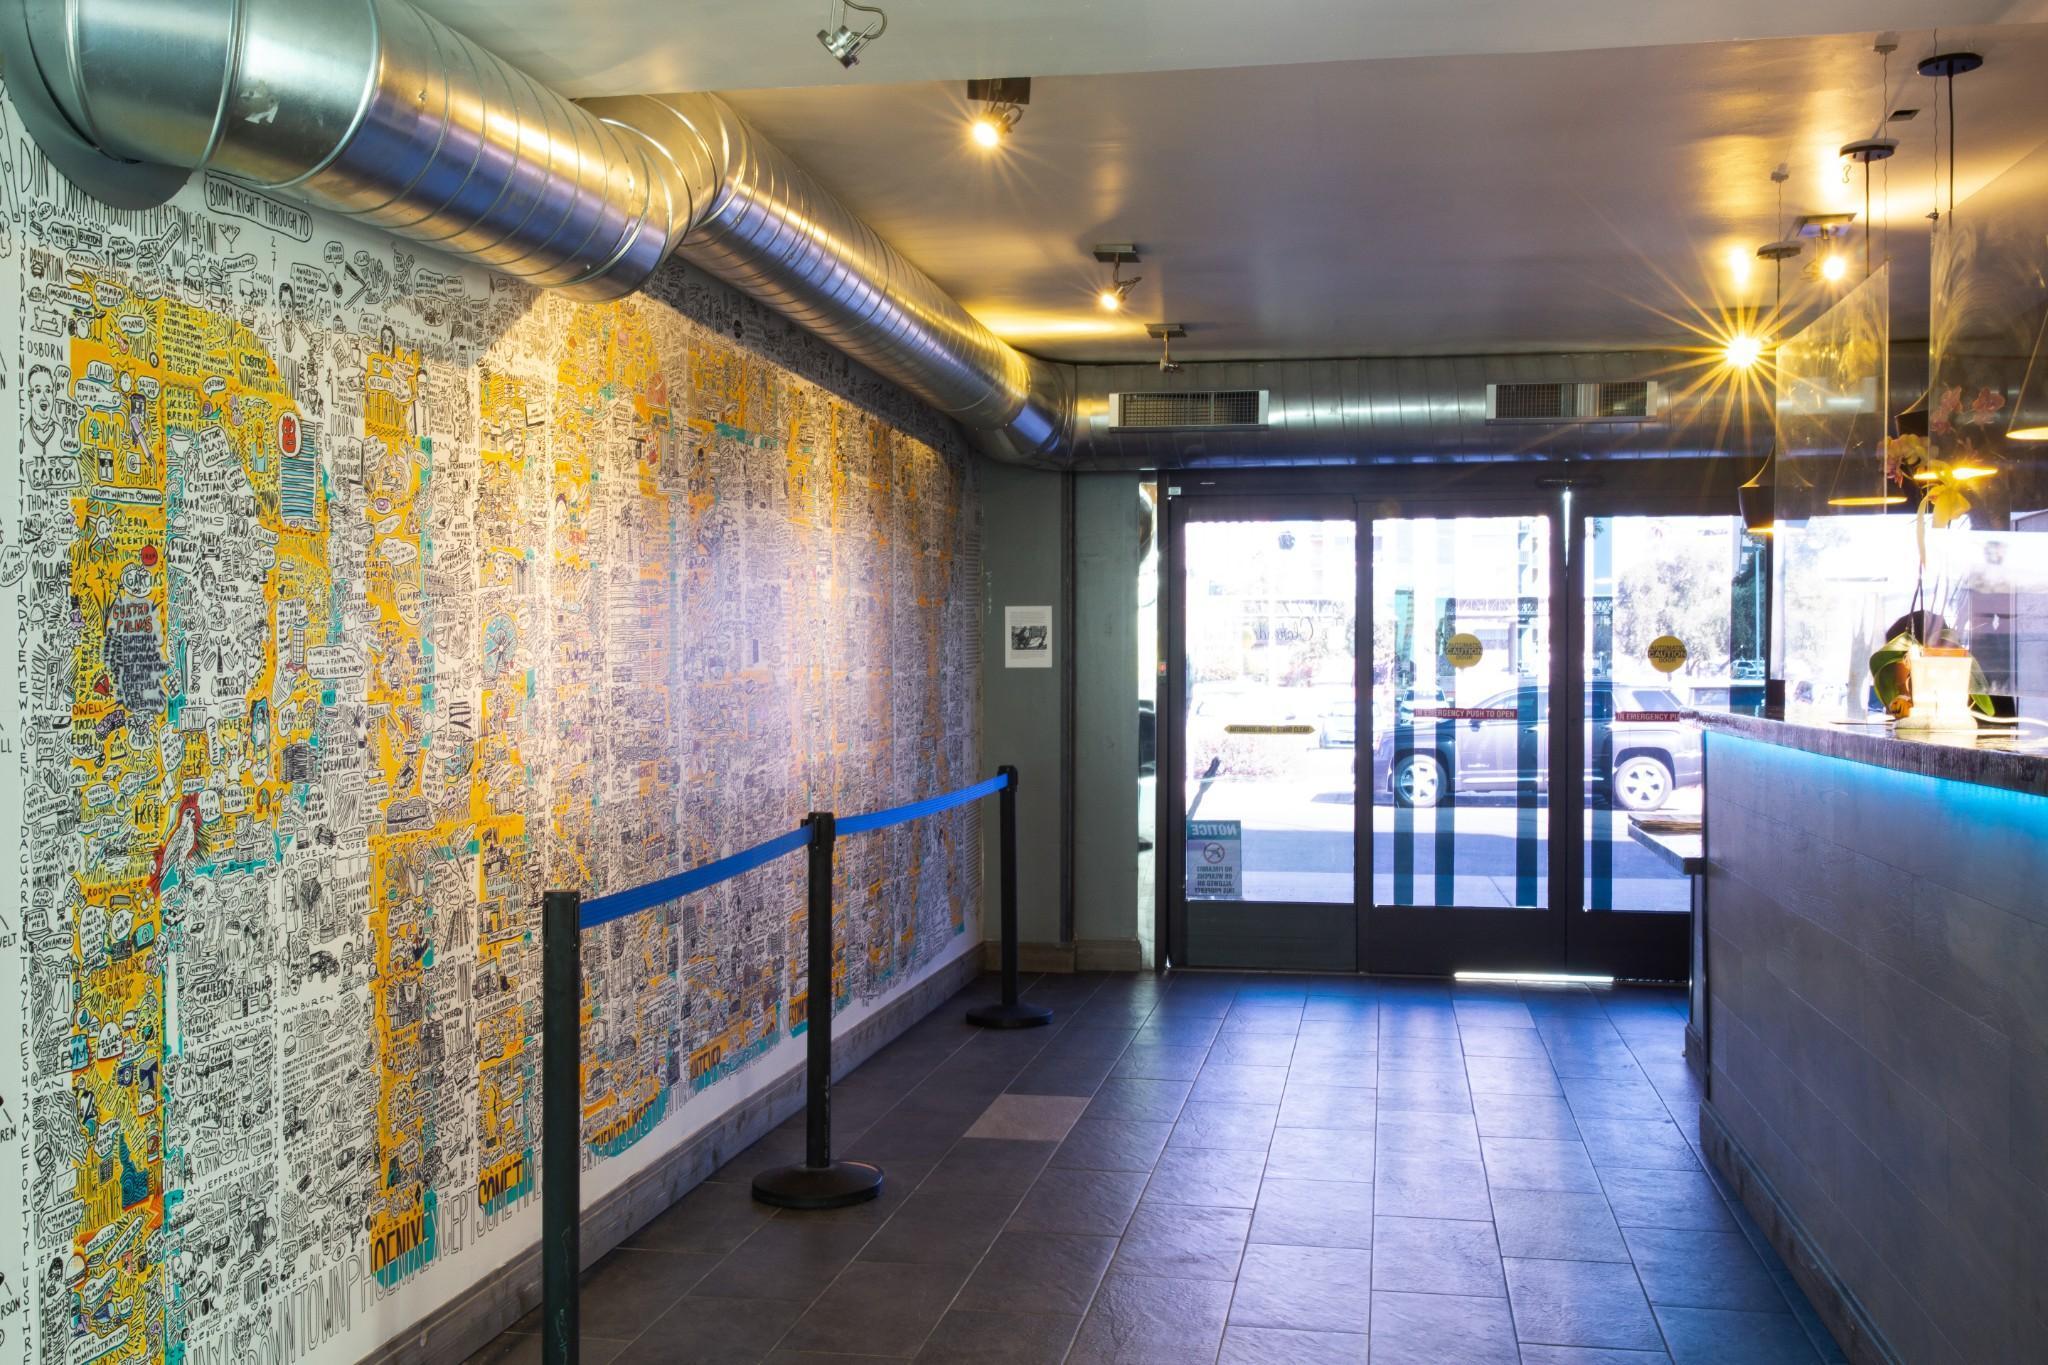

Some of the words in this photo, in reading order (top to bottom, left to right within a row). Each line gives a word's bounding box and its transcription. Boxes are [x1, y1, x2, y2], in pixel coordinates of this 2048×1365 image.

[209, 181, 234, 210] BOOM
[235, 190, 260, 218] RIGHT
[263, 200, 298, 234] THROUGH
[299, 214, 309, 237] YO
[77, 216, 111, 235] SCHOOL
[55, 236, 75, 247] STYLE
[79, 231, 102, 245] BURTON
[28, 340, 63, 361] OSBORN
[167, 362, 200, 377] BIGGER
[56, 382, 64, 391] BY
[166, 388, 197, 401] MICHAEL
[167, 411, 194, 422] BREAD
[200, 429, 220, 443] ACTOR
[63, 440, 79, 449] NOW
[204, 440, 226, 453] SLASH
[206, 450, 228, 464] MODEL
[32, 467, 76, 481] CARBON
[193, 470, 226, 482] IGLESIA
[188, 482, 226, 493] CRISTIANA
[1, 561, 25, 583] SUCCESS
[216, 583, 239, 594] CENTRO
[113, 603, 149, 618] CUATRO
[117, 617, 153, 633] PALMAS
[123, 681, 161, 692] VENEZUELA
[125, 691, 142, 700] PERU
[126, 700, 163, 710] ARGENTINA
[1424, 709, 1464, 717] EMERGENCY
[1466, 709, 1484, 717] PUSH
[1487, 709, 1494, 717] TO
[74, 719, 97, 730] TACOS
[38, 737, 53, 745] FOOD
[38, 746, 54, 754] CITY
[201, 808, 219, 819] PARK
[131, 832, 160, 841] PORTLAND
[91, 957, 144, 987] REYNOLDS
[105, 980, 134, 1001] PARK
[280, 1006, 298, 1016] VAN
[301, 994, 334, 1011] BUREN
[184, 1033, 219, 1048] BUREN
[222, 1026, 241, 1036] VAN
[244, 1014, 273, 1028] BUREN
[35, 1079, 64, 1094] VAN
[204, 1163, 249, 1191] JEFFERSON
[58, 1205, 84, 1219] MAKING
[53, 1221, 64, 1230] THE
[66, 1214, 79, 1225] WAY
[423, 1186, 477, 1266] EXCEPT
[73, 1328, 128, 1365] ADMINISTRATION
[73, 1345, 82, 1356] AM
[83, 1337, 96, 1349] THE
